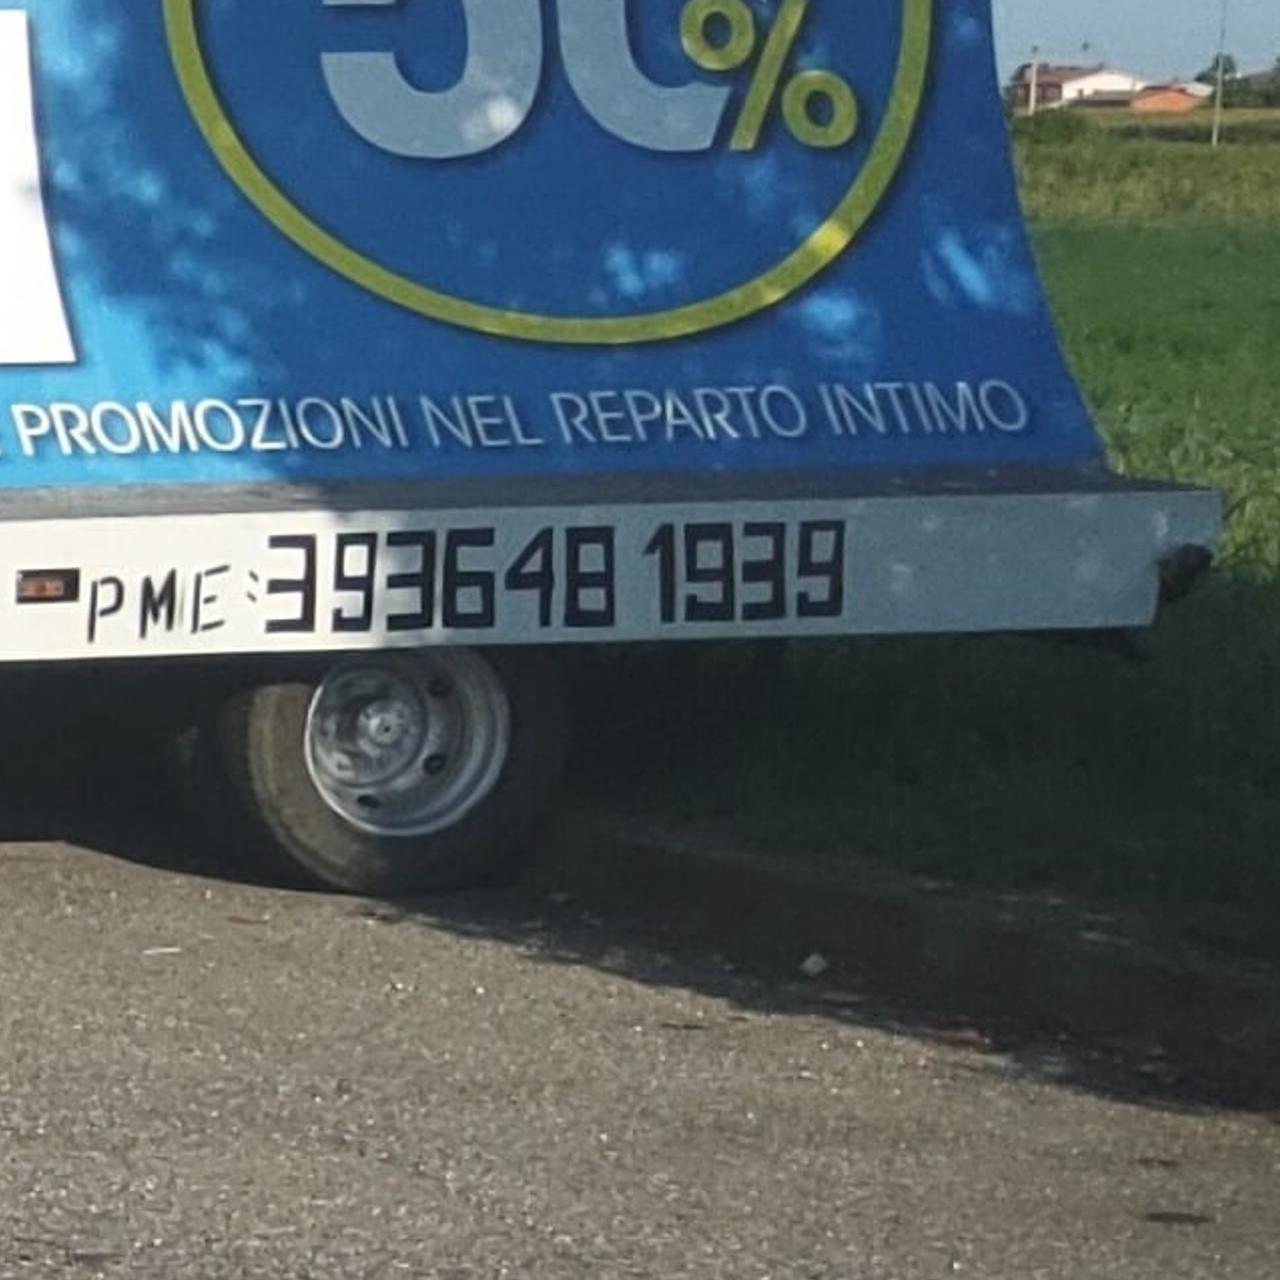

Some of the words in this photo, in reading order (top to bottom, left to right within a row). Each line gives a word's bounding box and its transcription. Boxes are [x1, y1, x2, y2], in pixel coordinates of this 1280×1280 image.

[17, 394, 407, 458] PROMOZIONI
[422, 391, 542, 448] NEL
[550, 385, 807, 443] REPARTO
[823, 379, 1028, 435] INTIMO
